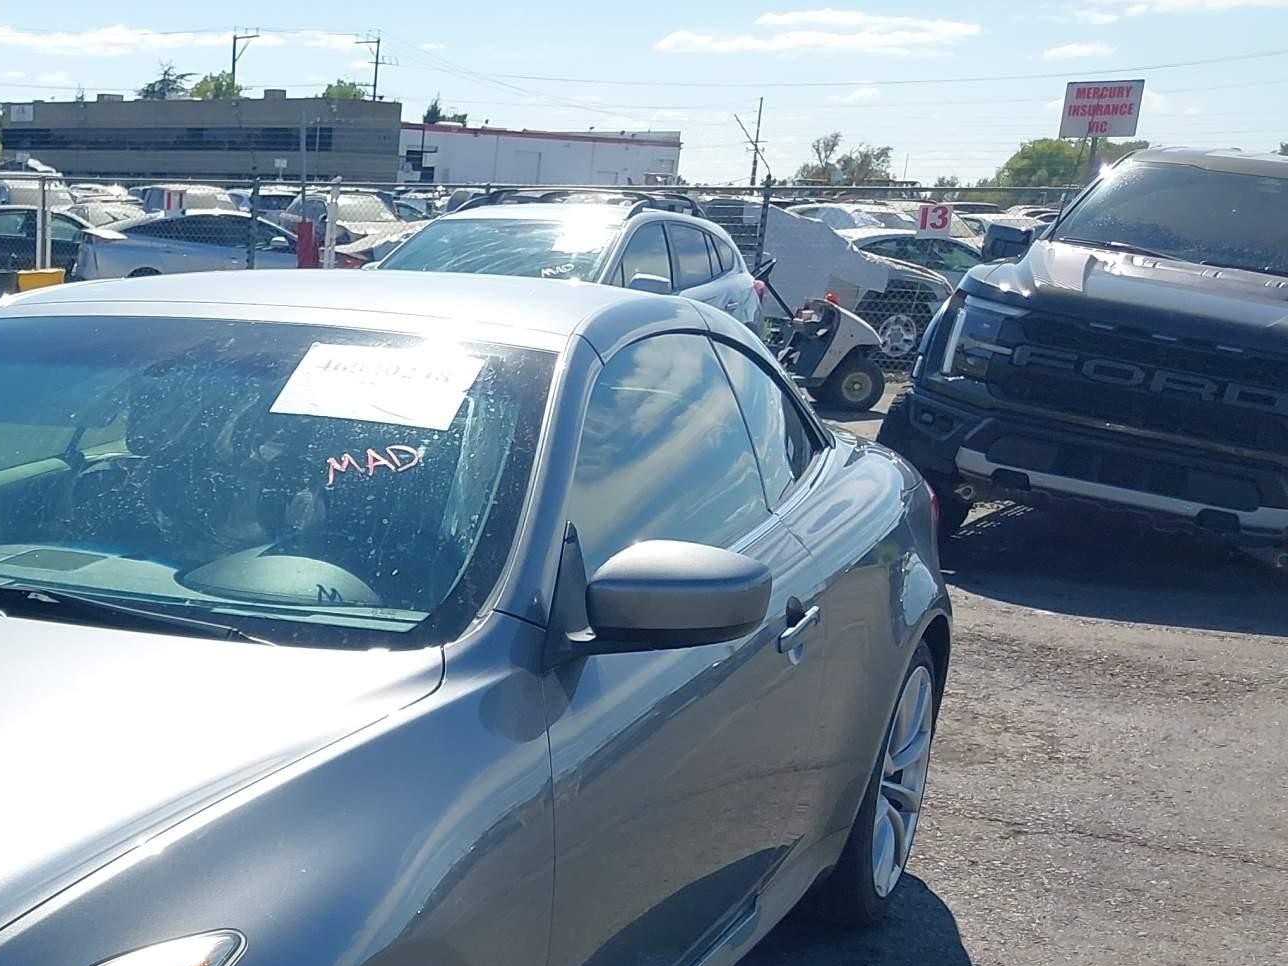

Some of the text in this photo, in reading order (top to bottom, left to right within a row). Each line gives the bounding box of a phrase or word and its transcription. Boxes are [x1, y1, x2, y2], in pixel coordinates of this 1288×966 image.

[1075, 85, 1133, 99] MERCURY
[1068, 103, 1134, 117] INSURANCE
[919, 206, 949, 229] 13
[1012, 344, 1288, 415] FORD
[326, 445, 419, 487] MAD
